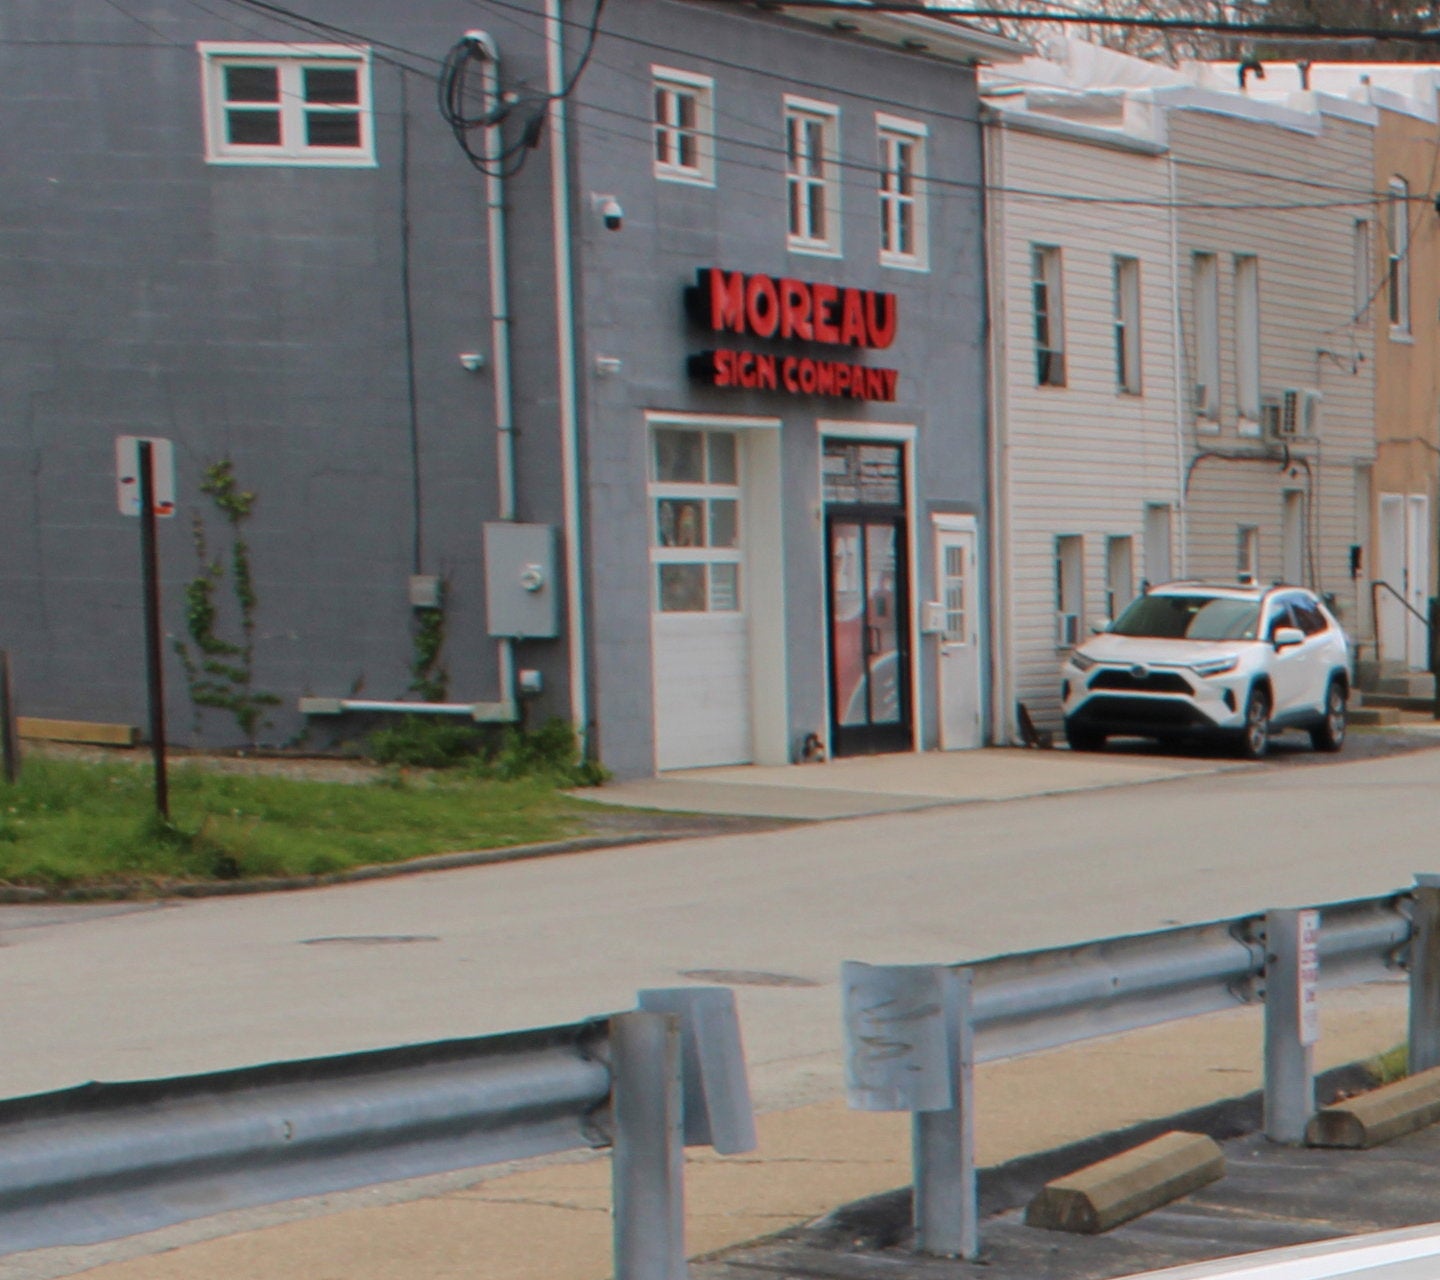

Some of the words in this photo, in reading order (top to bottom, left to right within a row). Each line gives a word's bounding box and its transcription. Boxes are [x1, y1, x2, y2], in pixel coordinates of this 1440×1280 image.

[710, 267, 897, 349] MOREAU
[713, 349, 776, 390] SIGN
[782, 355, 898, 402] COMPANY
